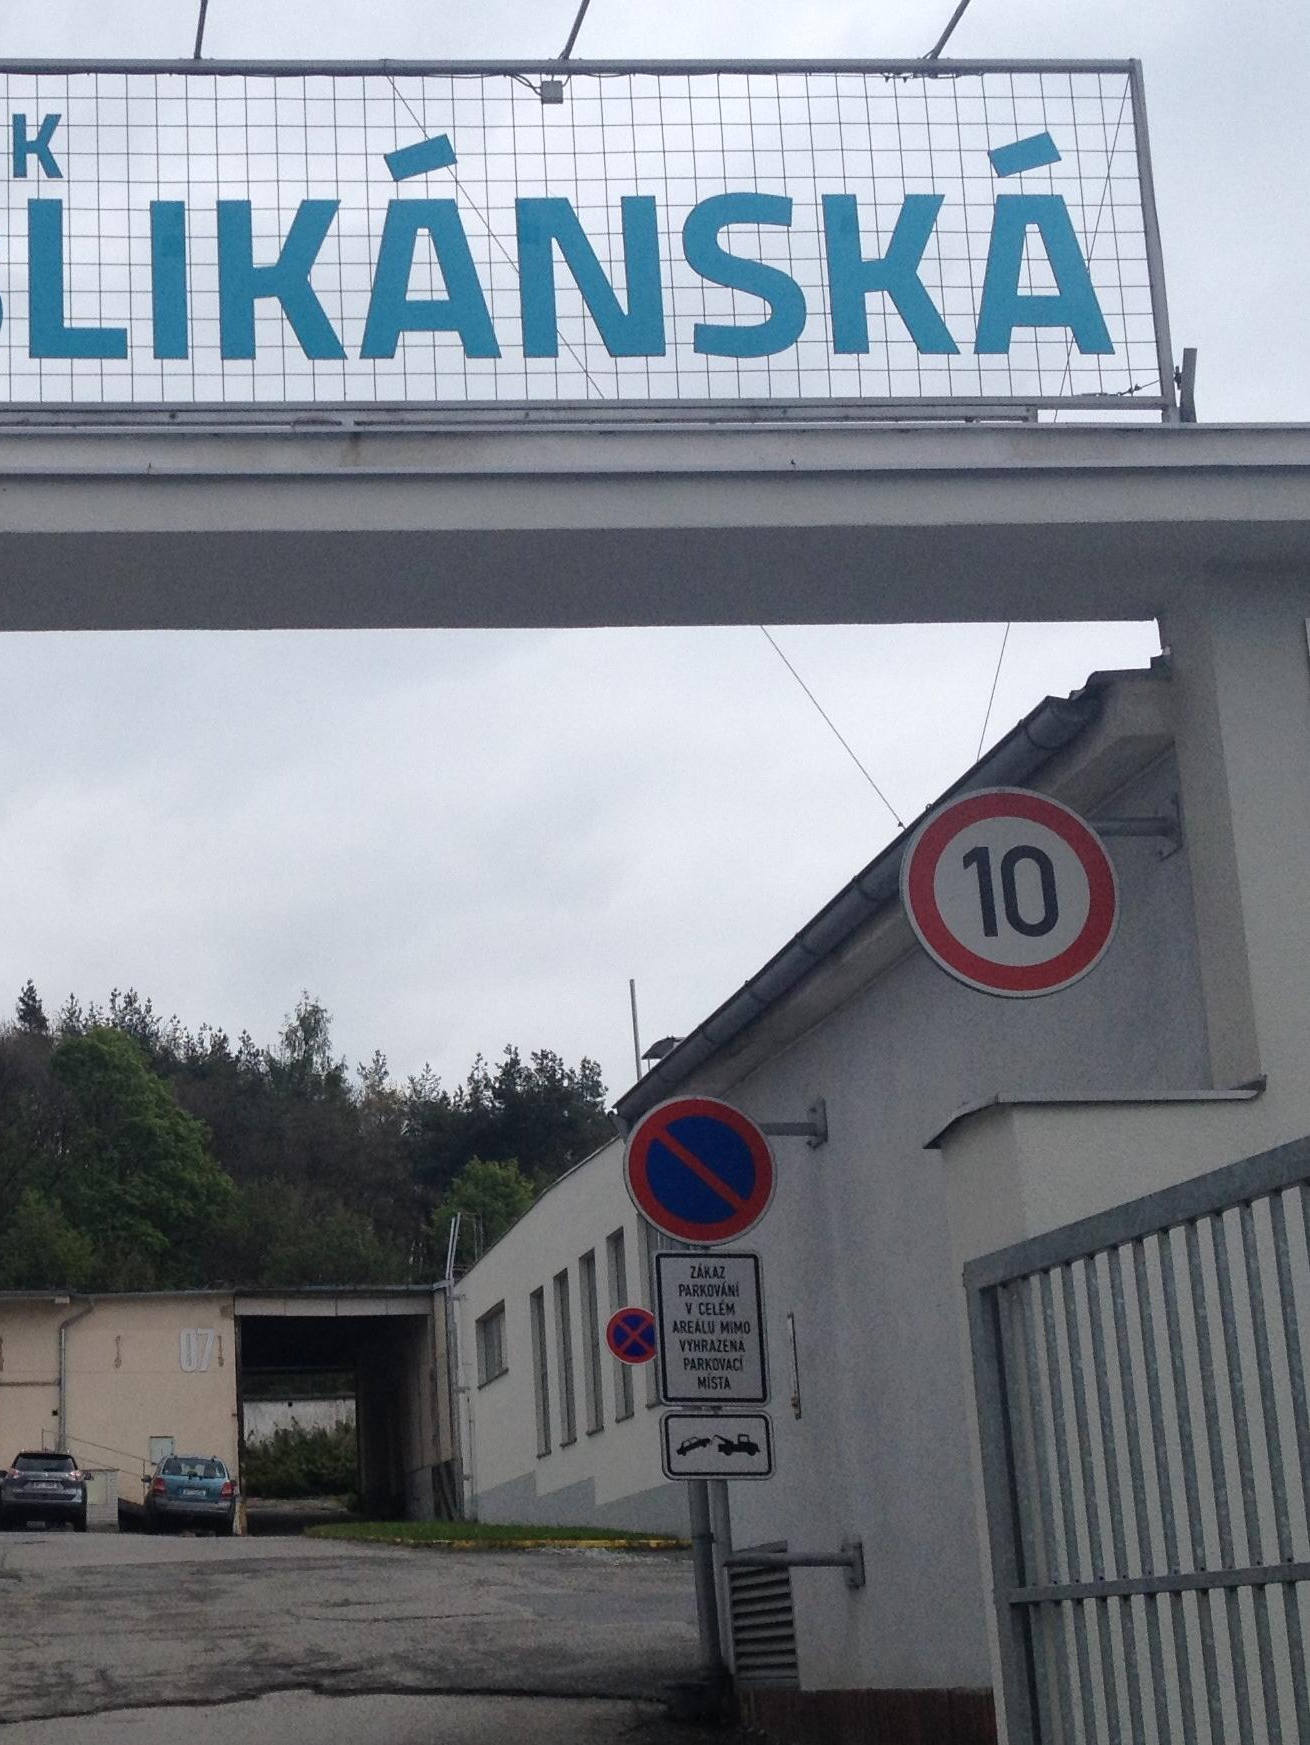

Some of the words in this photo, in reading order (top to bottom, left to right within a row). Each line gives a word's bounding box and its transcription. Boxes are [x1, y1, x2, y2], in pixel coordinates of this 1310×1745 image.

[962, 844, 1060, 938] 10
[690, 1263, 726, 1279] ZÁKAZ
[678, 1281, 740, 1298] PARKOVÁNÍ
[685, 1302, 693, 1315] V
[698, 1299, 736, 1316] CELÉM
[720, 1320, 751, 1335] MIMO
[178, 1327, 215, 1373] 07
[683, 1354, 744, 1372] PARKOVACÍ
[697, 1372, 732, 1390] MÍSTA
